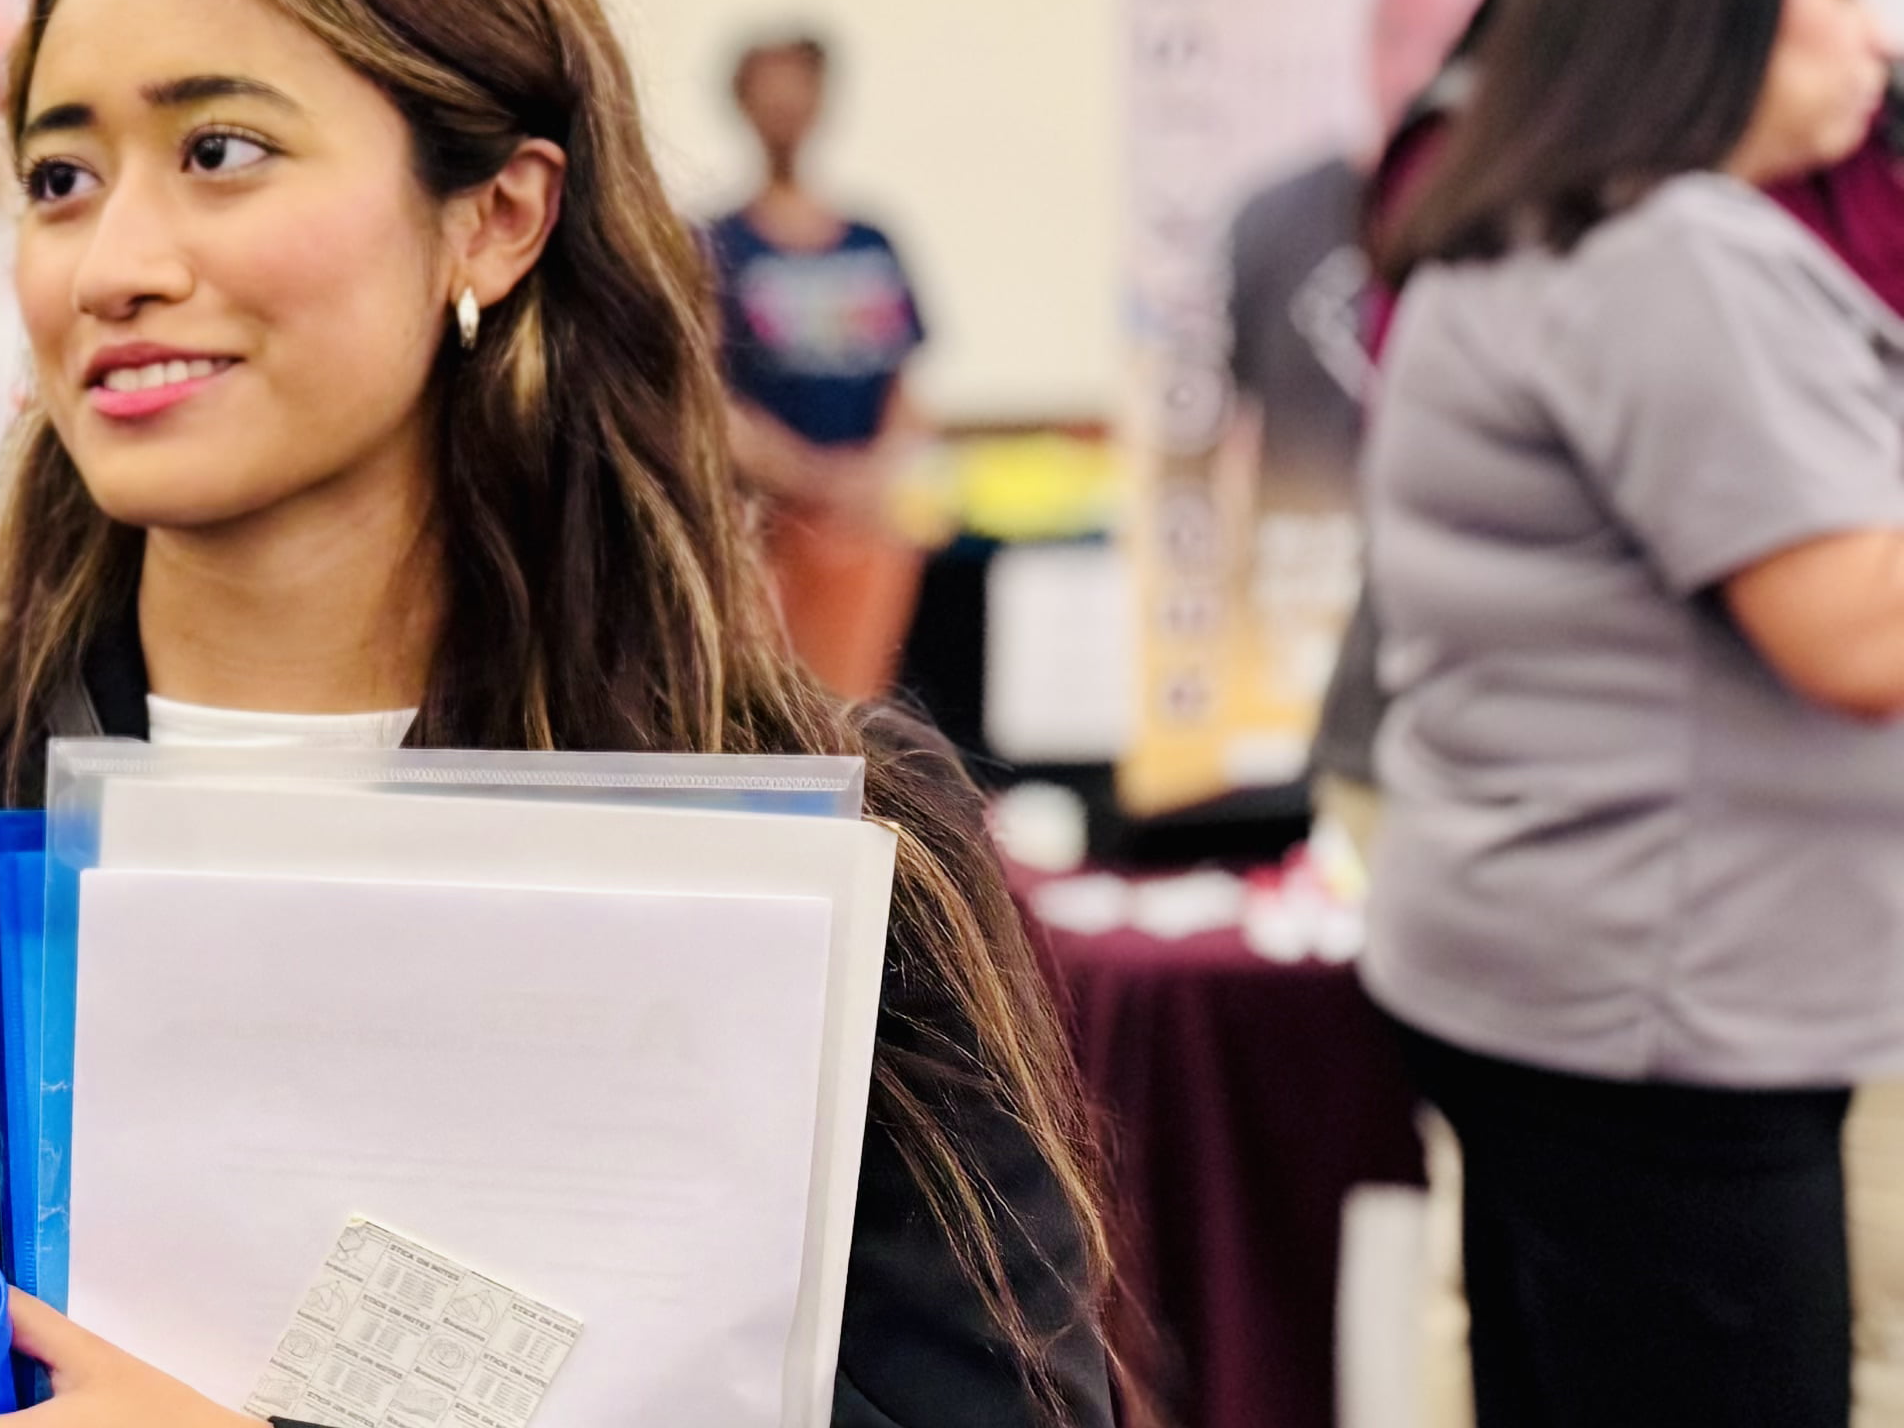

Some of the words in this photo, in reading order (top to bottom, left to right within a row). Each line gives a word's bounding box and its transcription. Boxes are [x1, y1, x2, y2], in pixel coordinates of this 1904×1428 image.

[389, 1243, 414, 1260] STICK
[414, 1255, 431, 1268] ON
[429, 1262, 460, 1282] NOTES
[361, 1292, 388, 1310] STICK
[387, 1305, 402, 1317] ON
[401, 1311, 431, 1331] NOTES
[510, 1302, 538, 1320] STICK
[537, 1314, 553, 1327] ON
[333, 1341, 360, 1359] STICK
[358, 1353, 374, 1365] ON
[373, 1360, 403, 1379] NOTES
[482, 1352, 509, 1370] STICK
[507, 1364, 524, 1377] ON
[305, 1389, 332, 1407] STICK
[330, 1401, 347, 1414] ON
[345, 1409, 376, 1428] NOTES
[453, 1401, 480, 1419] STICK
[480, 1414, 495, 1427] ON
